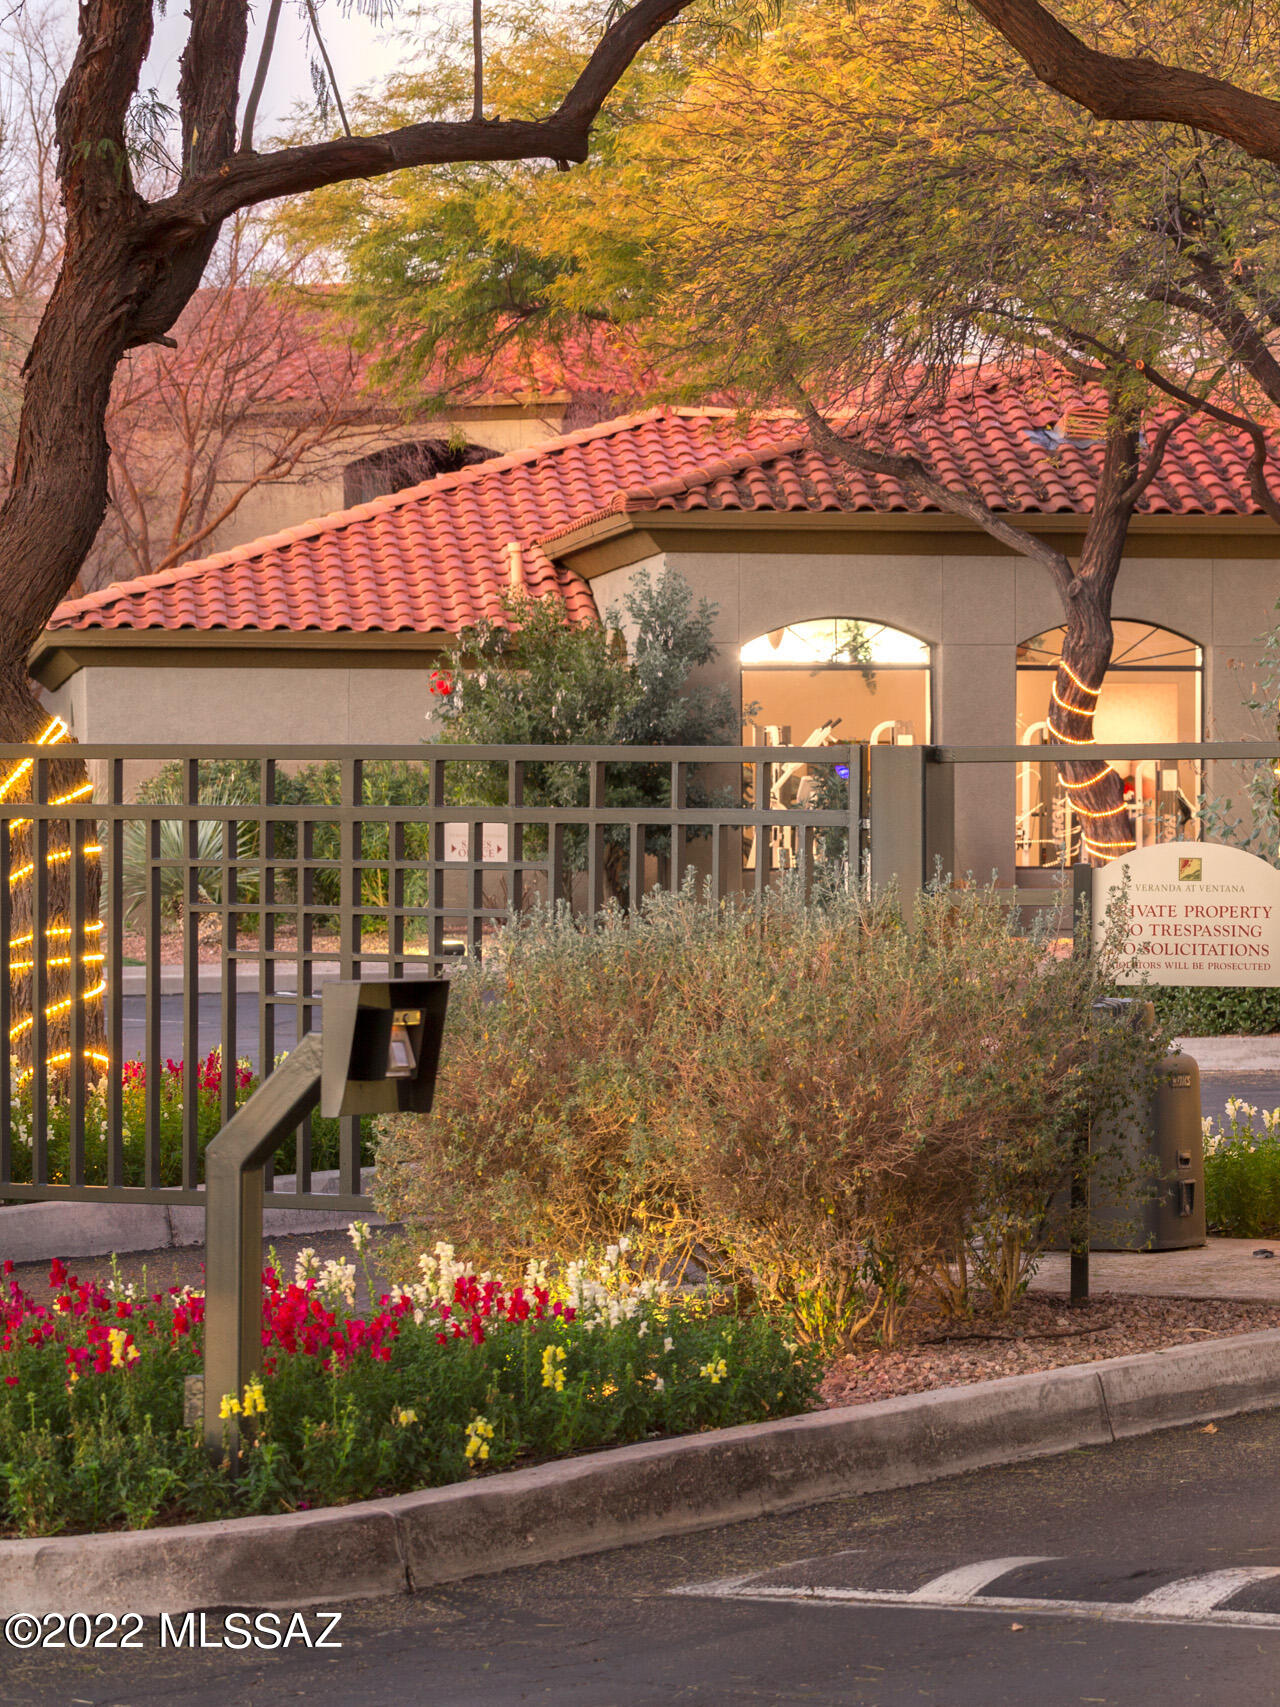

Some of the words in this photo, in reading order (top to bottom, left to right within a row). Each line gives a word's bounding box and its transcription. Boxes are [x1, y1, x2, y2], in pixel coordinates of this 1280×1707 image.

[1135, 884, 1182, 893] VERANDA
[1185, 884, 1197, 893] AT
[1199, 884, 1246, 894] VENTANA
[1184, 905, 1273, 919] PROPERTY
[1149, 923, 1263, 938] TRESPASSING
[1142, 942, 1271, 957] SOLICITATIONS
[1164, 961, 1189, 970] WILL
[1192, 961, 1204, 970] BE
[1207, 962, 1271, 971] PROSECUTED
